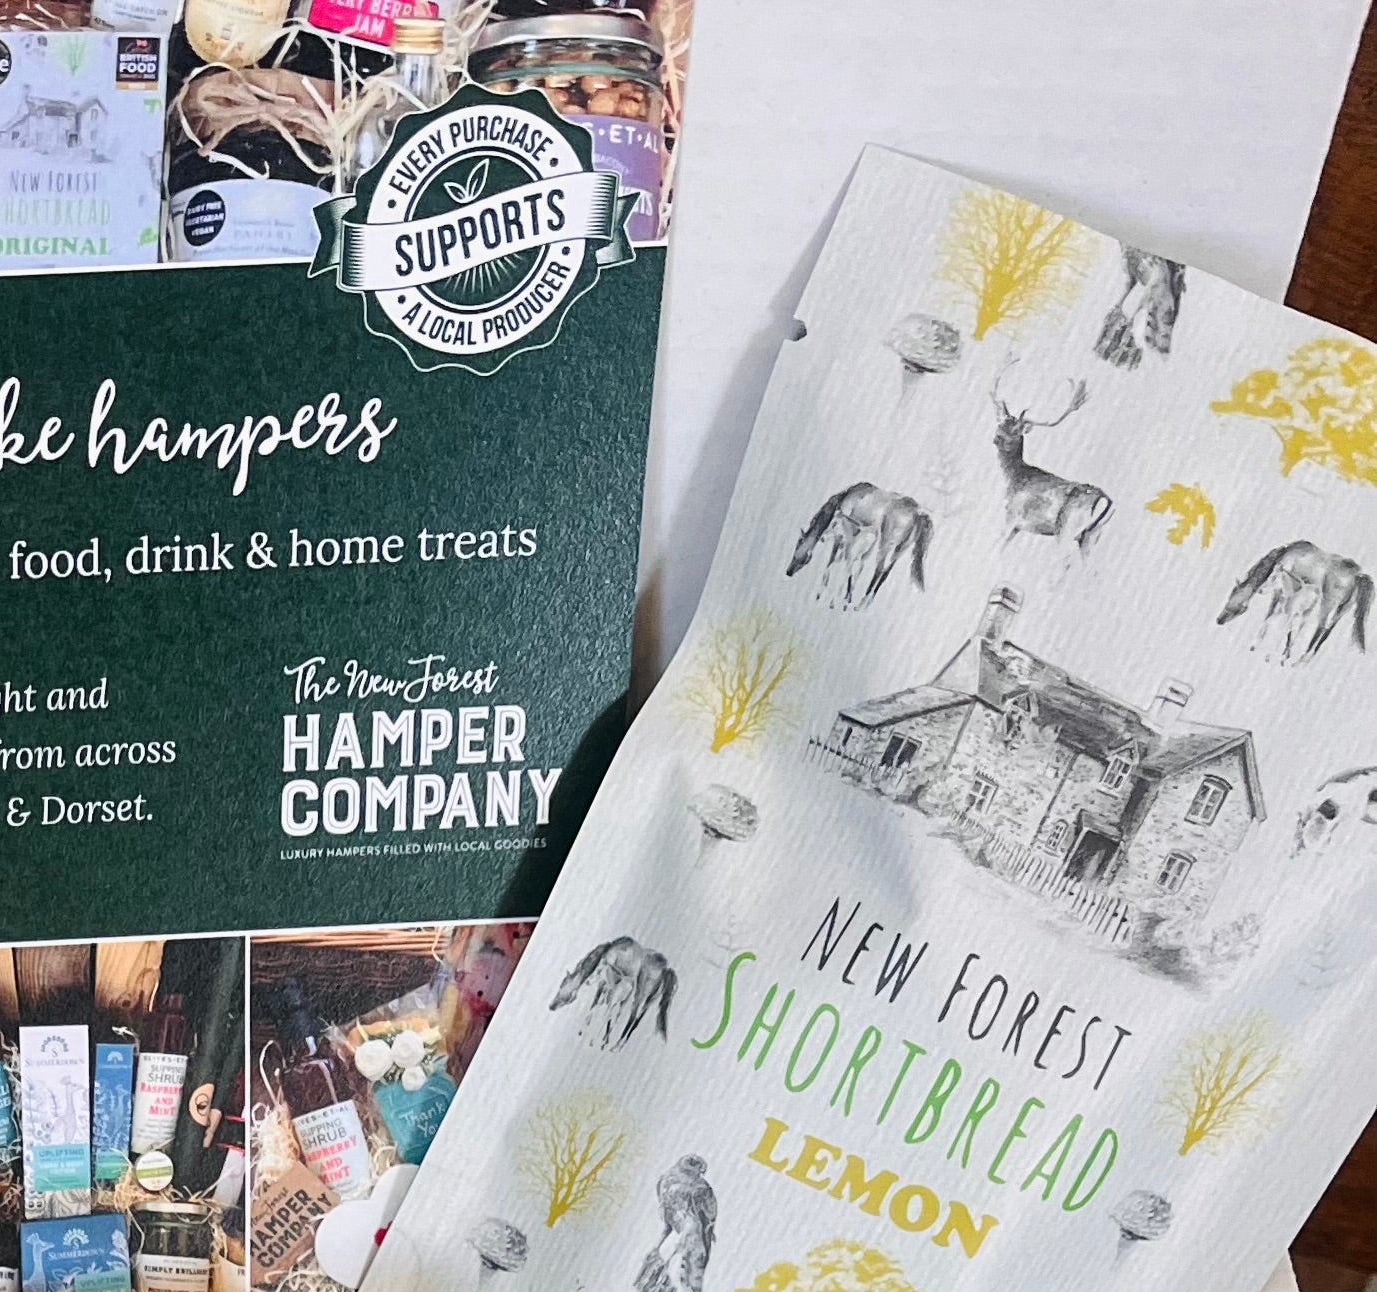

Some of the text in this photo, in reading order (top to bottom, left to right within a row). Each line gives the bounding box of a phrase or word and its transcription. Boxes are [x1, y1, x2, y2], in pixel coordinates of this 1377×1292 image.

[354, 13, 385, 38] JAM
[119, 62, 156, 74] FOOD
[388, 115, 554, 195] EVERY PURCHASE
[395, 189, 566, 277] SUPPORTS
[402, 263, 572, 346] A LOCAL PRODUCER
[86, 378, 398, 496] hampers
[9, 540, 113, 583] food,
[125, 531, 235, 577] drink
[246, 532, 277, 570] &
[289, 528, 405, 567] home
[418, 523, 539, 563] treats
[46, 677, 109, 713] and
[283, 653, 500, 705] The New Forest
[74, 736, 178, 769] across
[282, 704, 526, 772] HAMPER
[6, 799, 32, 825] &
[41, 792, 153, 828] Dorset.
[280, 767, 562, 837] COMPANY
[280, 838, 547, 860] LUXURY HAMPERS FILLED WITH LOCAL GOODIES
[801, 897, 1132, 1091] NEW FOREST
[691, 951, 1119, 1212] SHORTBREAD
[303, 1127, 347, 1150] SHRUB
[398, 1102, 445, 1125] Thank
[417, 1121, 438, 1138] Yo
[747, 1117, 999, 1259] LEMON
[257, 1192, 331, 1268] COMPANY
